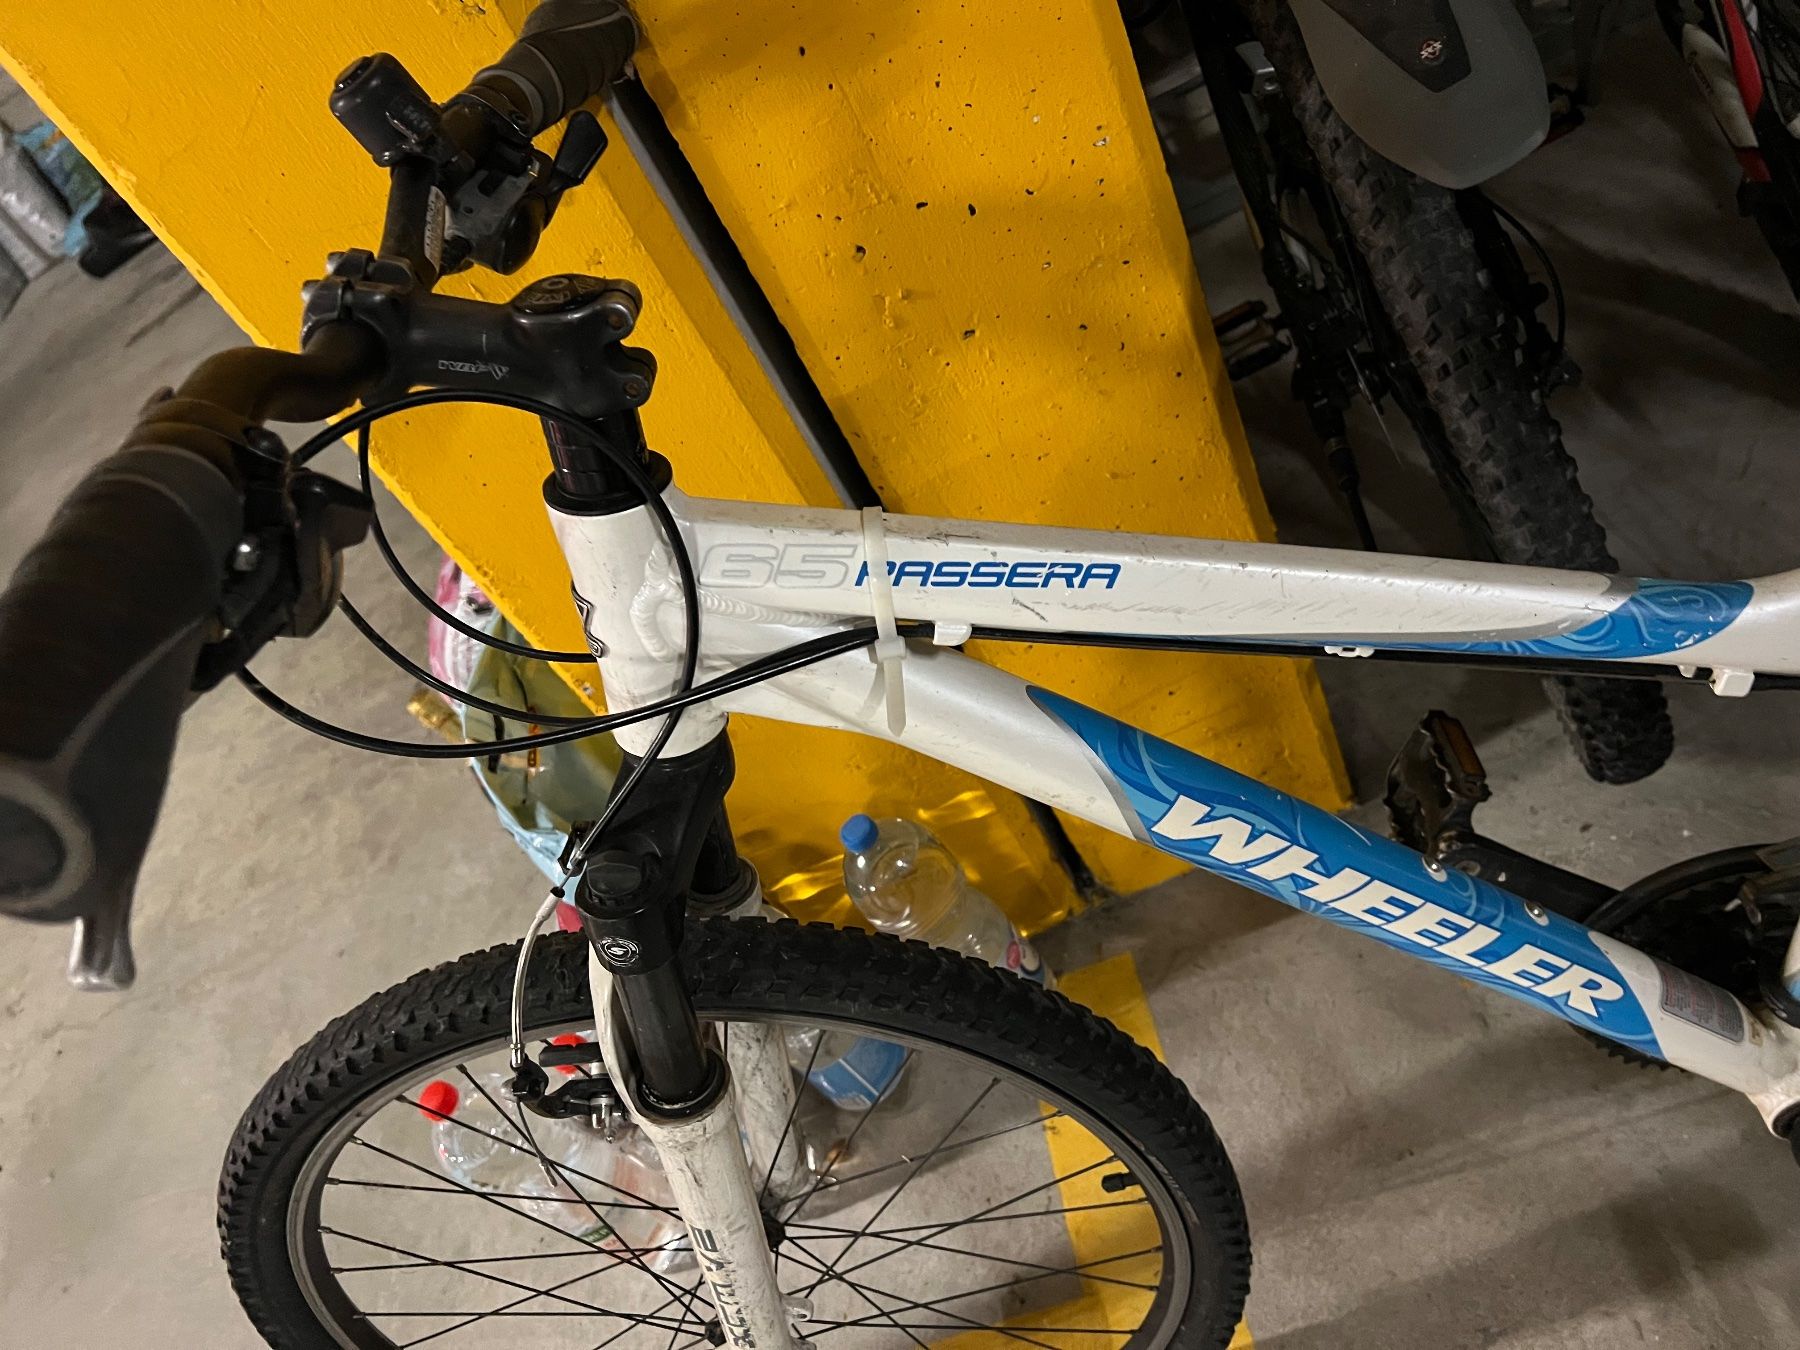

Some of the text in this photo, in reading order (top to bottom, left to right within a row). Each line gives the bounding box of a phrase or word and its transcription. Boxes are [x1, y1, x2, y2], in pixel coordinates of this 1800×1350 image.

[698, 543, 1121, 590] 65 PASSERA
[1151, 795, 1624, 1018] WHEELER
